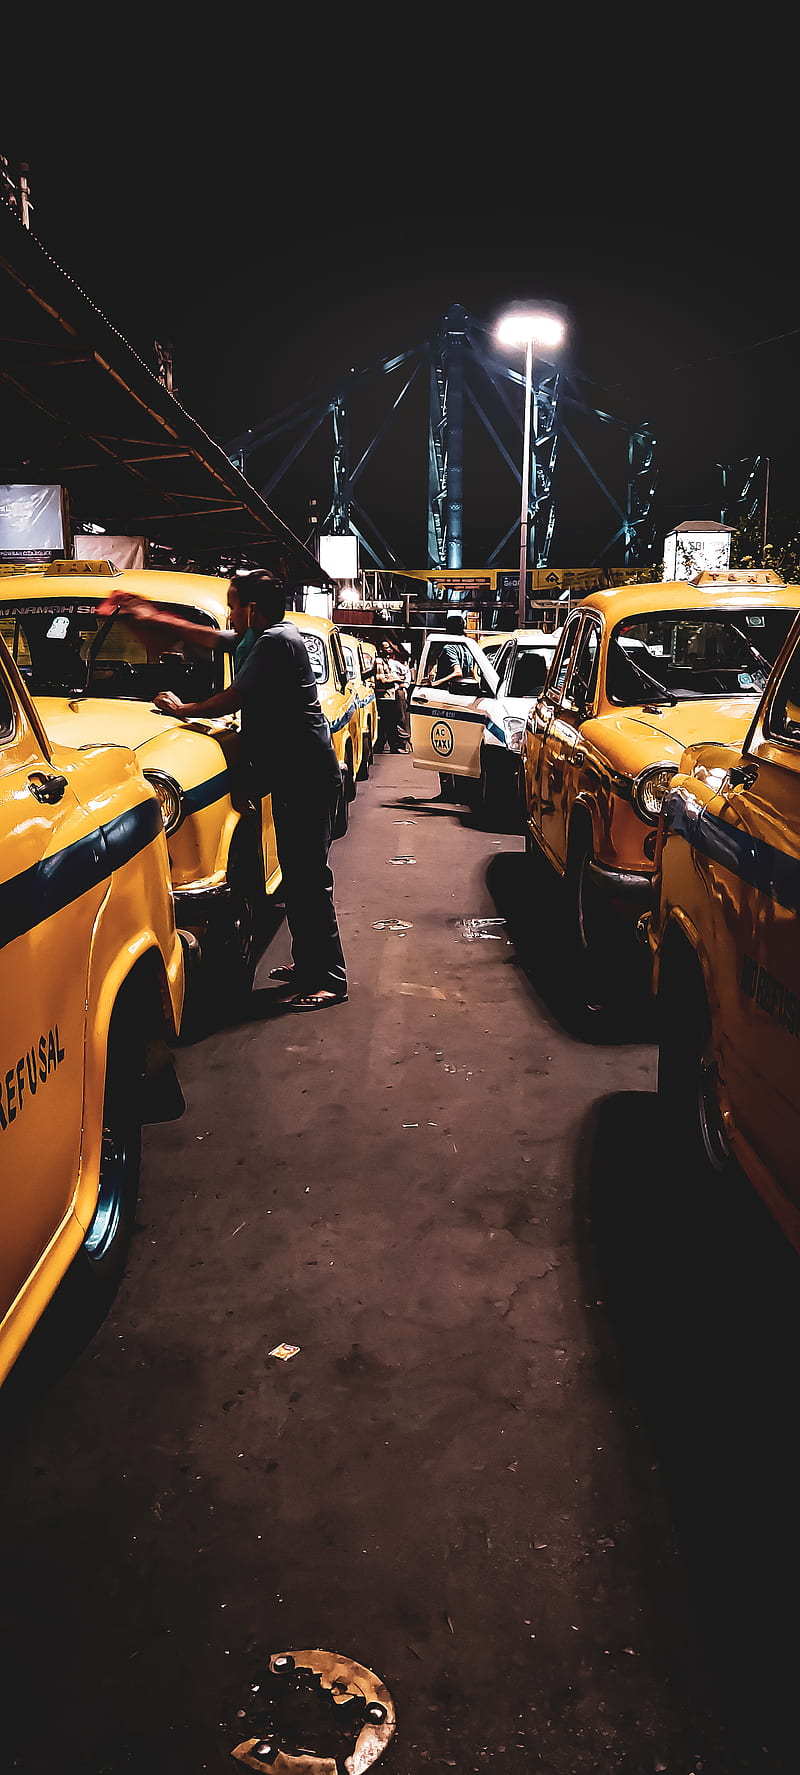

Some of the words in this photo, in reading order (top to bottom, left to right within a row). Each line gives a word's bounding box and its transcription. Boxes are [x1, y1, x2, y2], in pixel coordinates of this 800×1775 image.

[55, 563, 103, 573] TAXI
[708, 573, 772, 583] TAXI
[436, 728, 445, 737] AC
[434, 739, 451, 749] TAXI
